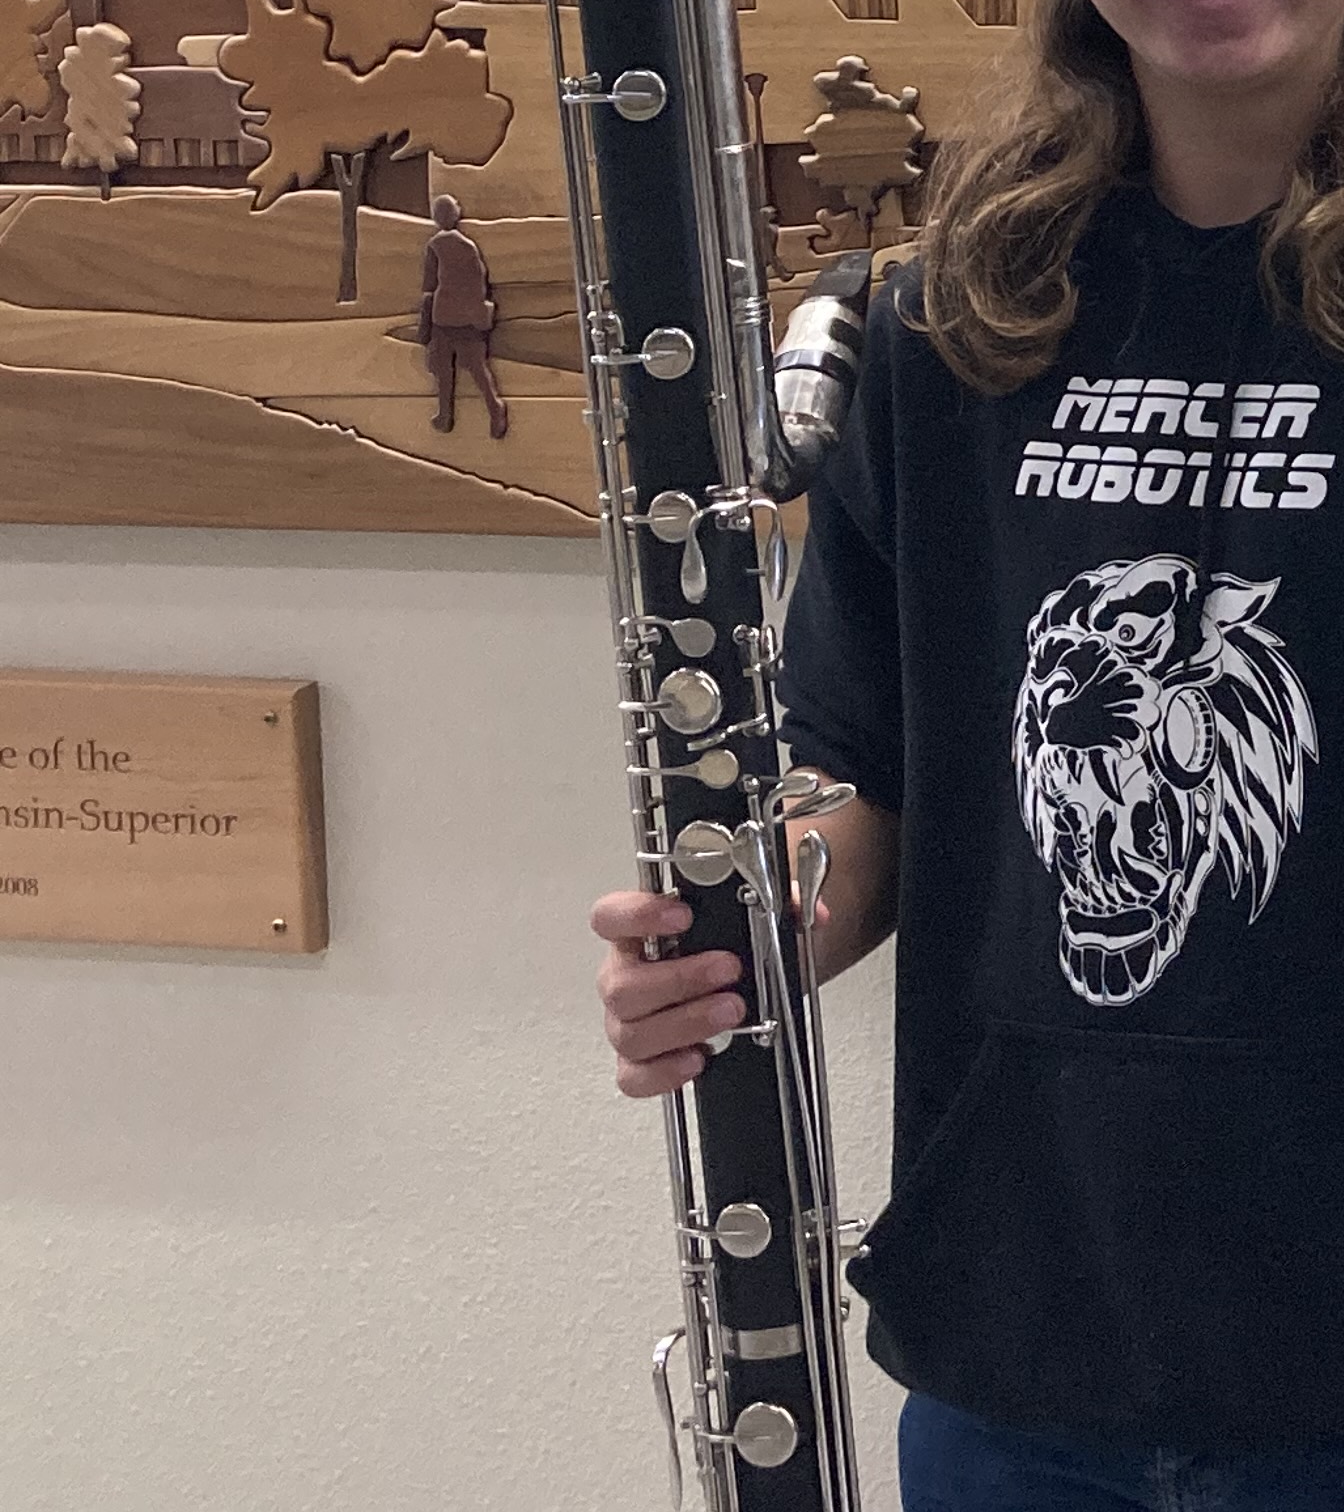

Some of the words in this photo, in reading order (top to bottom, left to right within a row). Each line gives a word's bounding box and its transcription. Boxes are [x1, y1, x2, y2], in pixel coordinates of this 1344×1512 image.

[1052, 376, 1320, 439] MERCER
[1015, 440, 1336, 510] ROBOTICS
[28, 736, 65, 771] of
[76, 738, 131, 774] the
